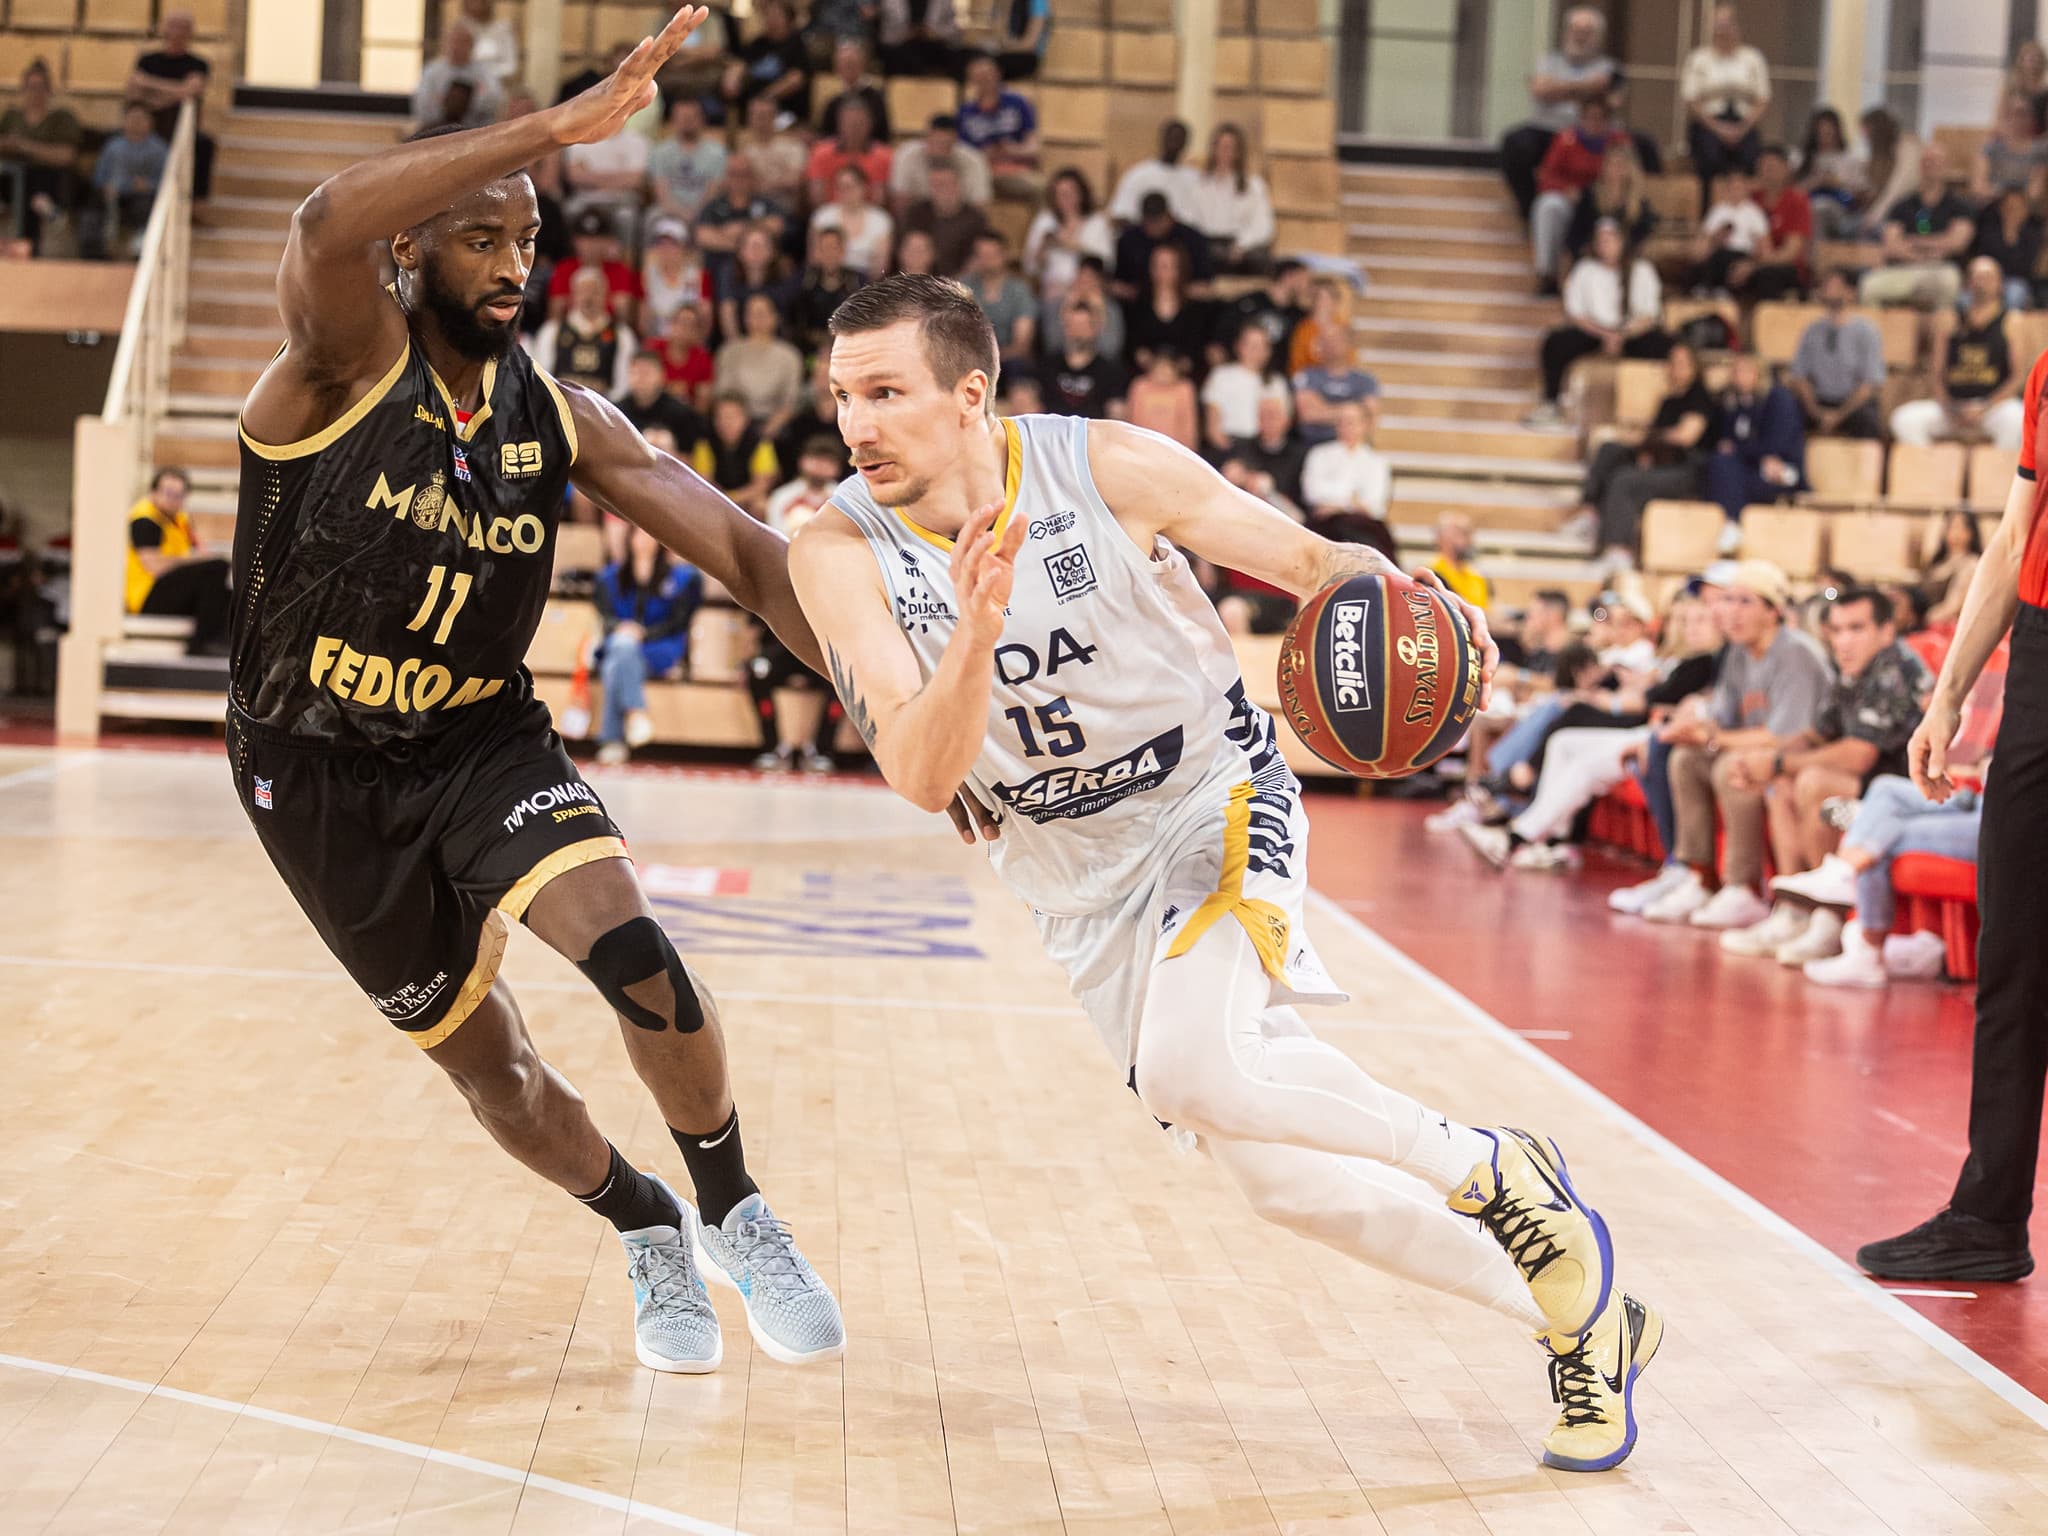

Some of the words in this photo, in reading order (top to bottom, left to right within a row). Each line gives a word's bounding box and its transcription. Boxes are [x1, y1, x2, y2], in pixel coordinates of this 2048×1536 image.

[1049, 520, 1075, 536] GROUP
[1051, 552, 1084, 575] 100
[406, 564, 473, 645] 11
[309, 635, 505, 714] FEDCOM
[1334, 605, 1364, 706] Betclic
[1401, 591, 1439, 727] SPALDING
[1004, 695, 1087, 758] 15
[1010, 747, 1162, 808] SERBA
[401, 971, 449, 1011] PASTOR
